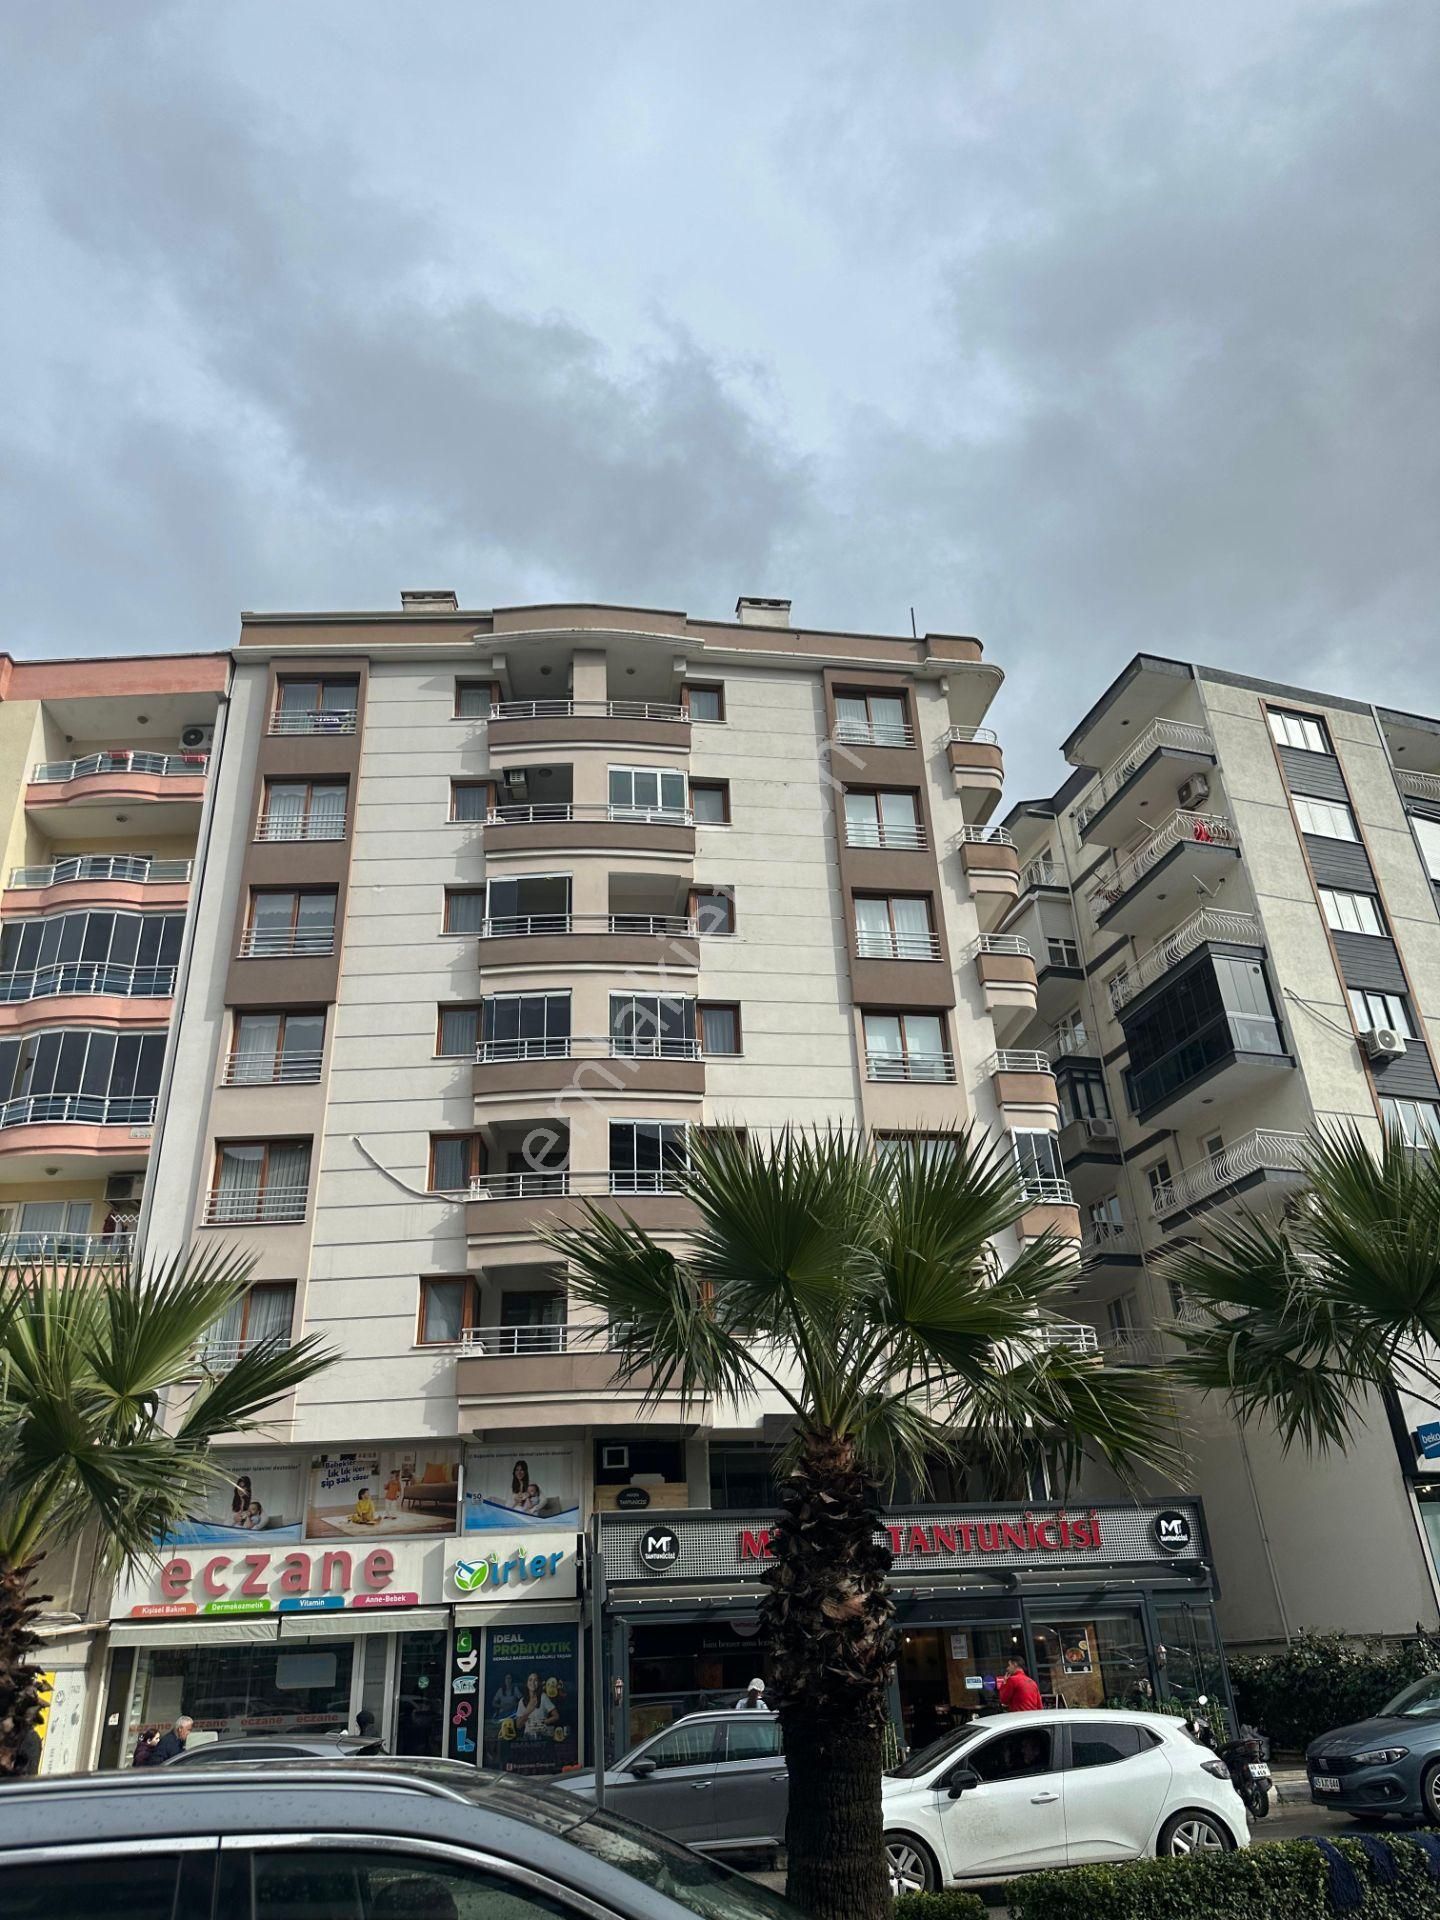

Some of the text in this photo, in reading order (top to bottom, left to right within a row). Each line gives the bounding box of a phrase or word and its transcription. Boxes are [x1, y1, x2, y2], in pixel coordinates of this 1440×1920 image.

[1421, 1432, 1440, 1444] beko
[887, 1509, 1102, 1554] TANTUNİCİSİ
[160, 1549, 395, 1598] eczane
[299, 1599, 325, 1608] Vitamin
[365, 1594, 406, 1604] Anne-Bebek
[240, 1715, 283, 1726] eczane
[295, 1712, 340, 1724] eczane
[192, 1719, 228, 1729] czane
